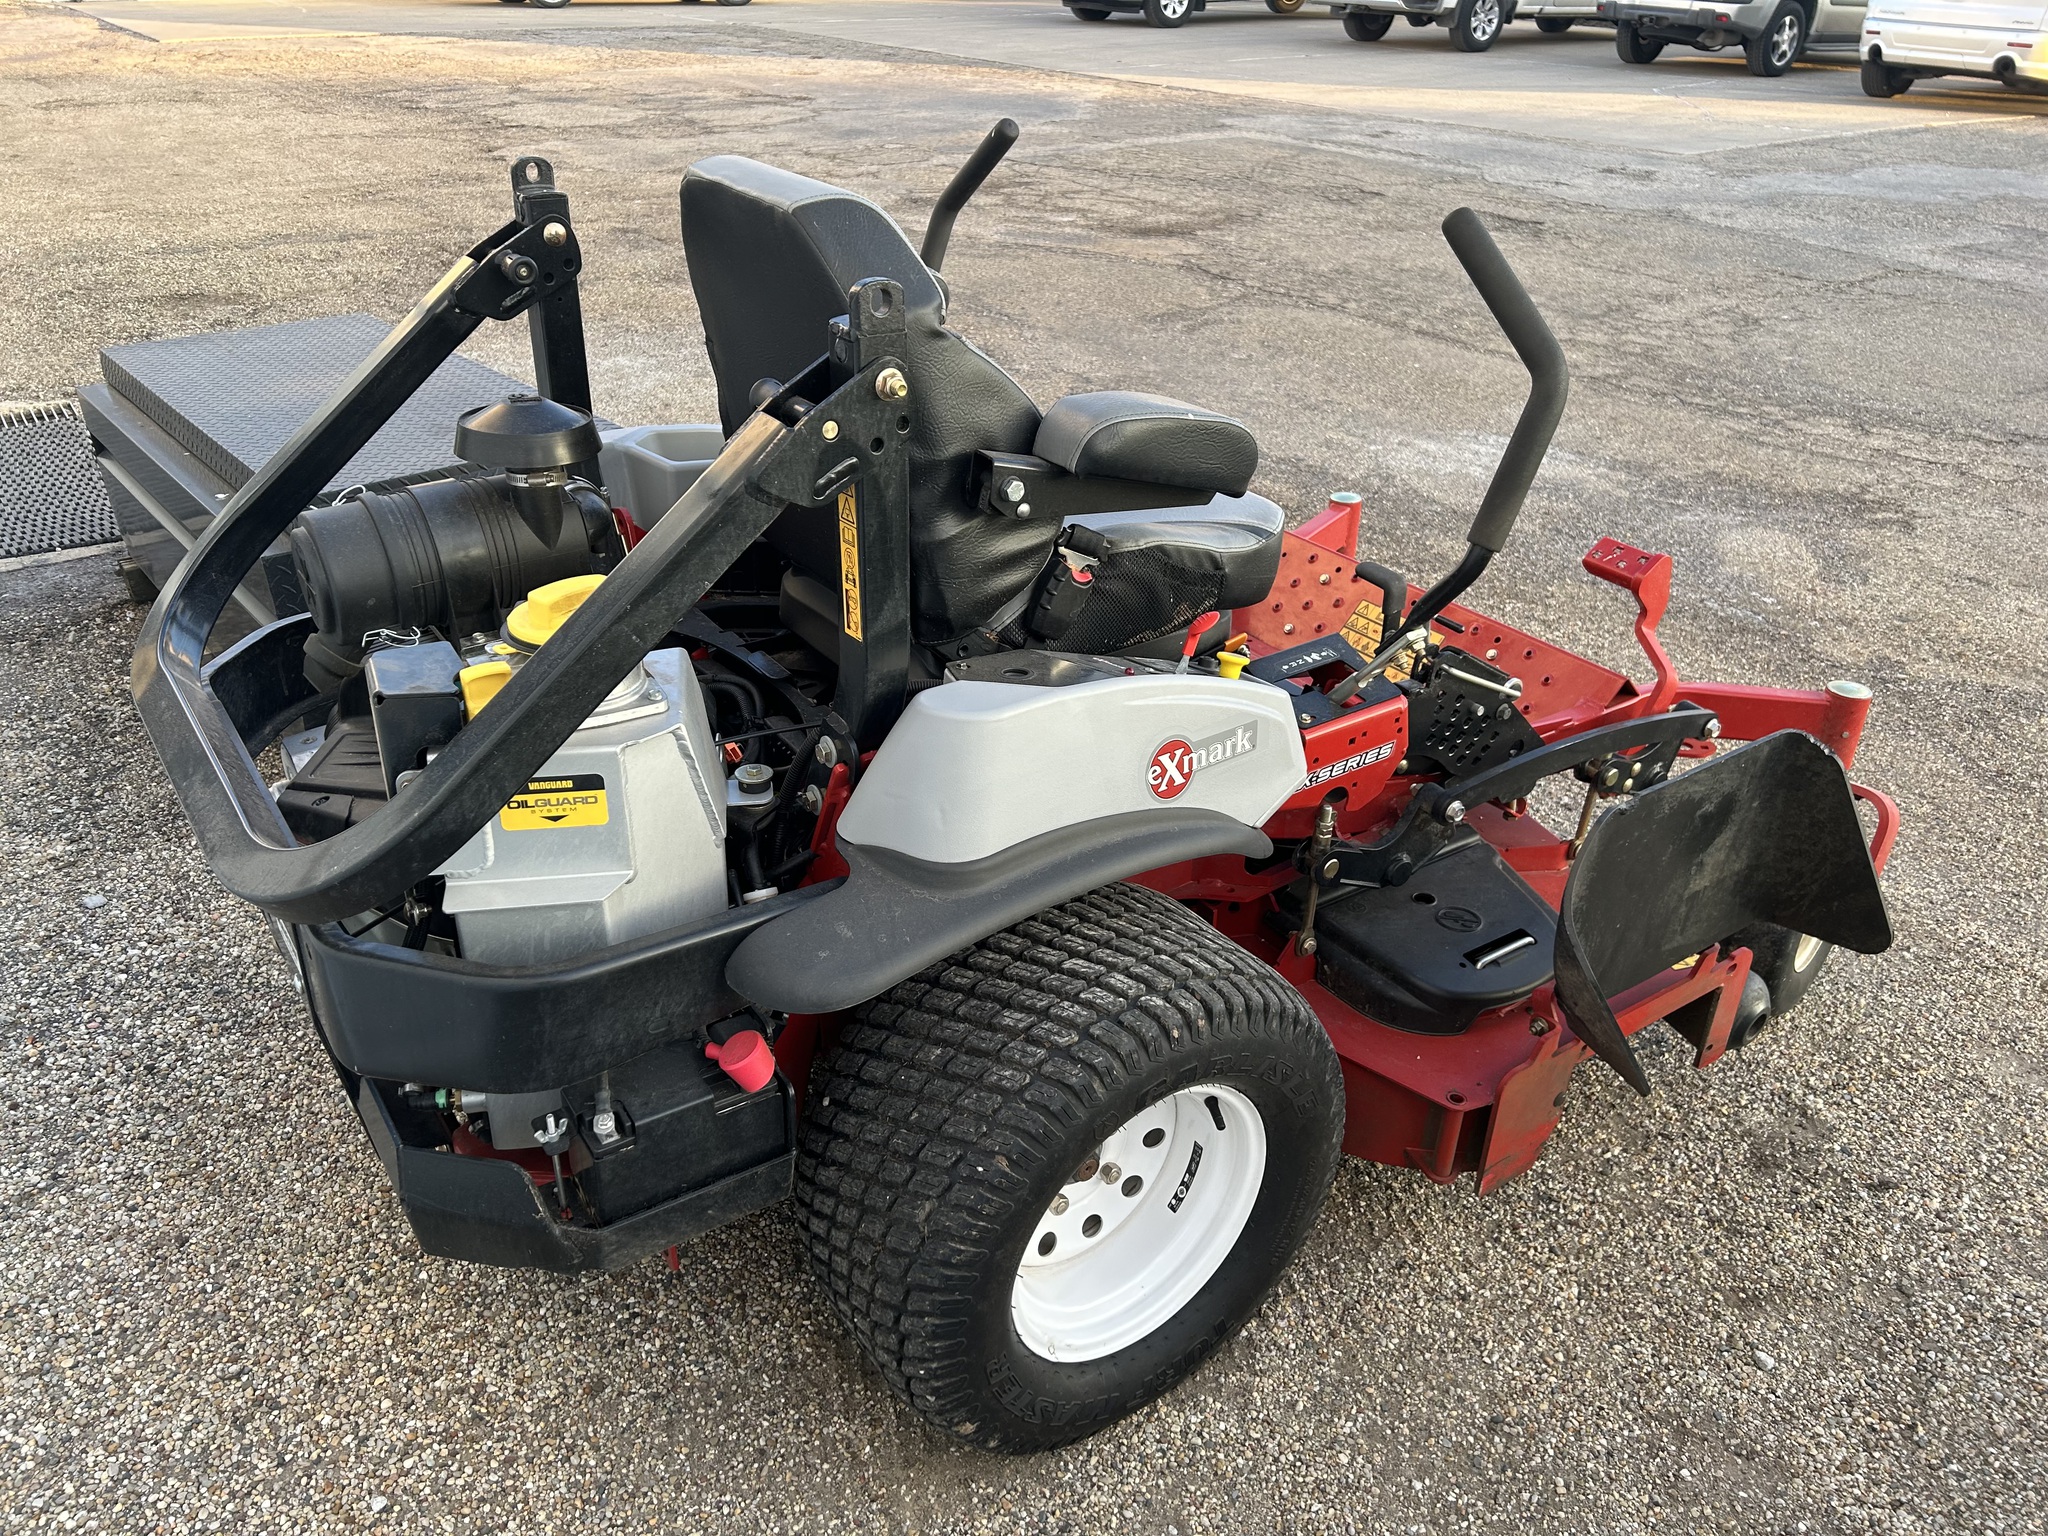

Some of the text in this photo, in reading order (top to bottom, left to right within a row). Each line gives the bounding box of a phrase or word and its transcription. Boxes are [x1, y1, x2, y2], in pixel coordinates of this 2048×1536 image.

[1147, 725, 1253, 793] eXmark
[527, 780, 573, 790] VANGUARD
[506, 794, 598, 810] OILGUARD
[530, 807, 578, 815] SYSTEM
